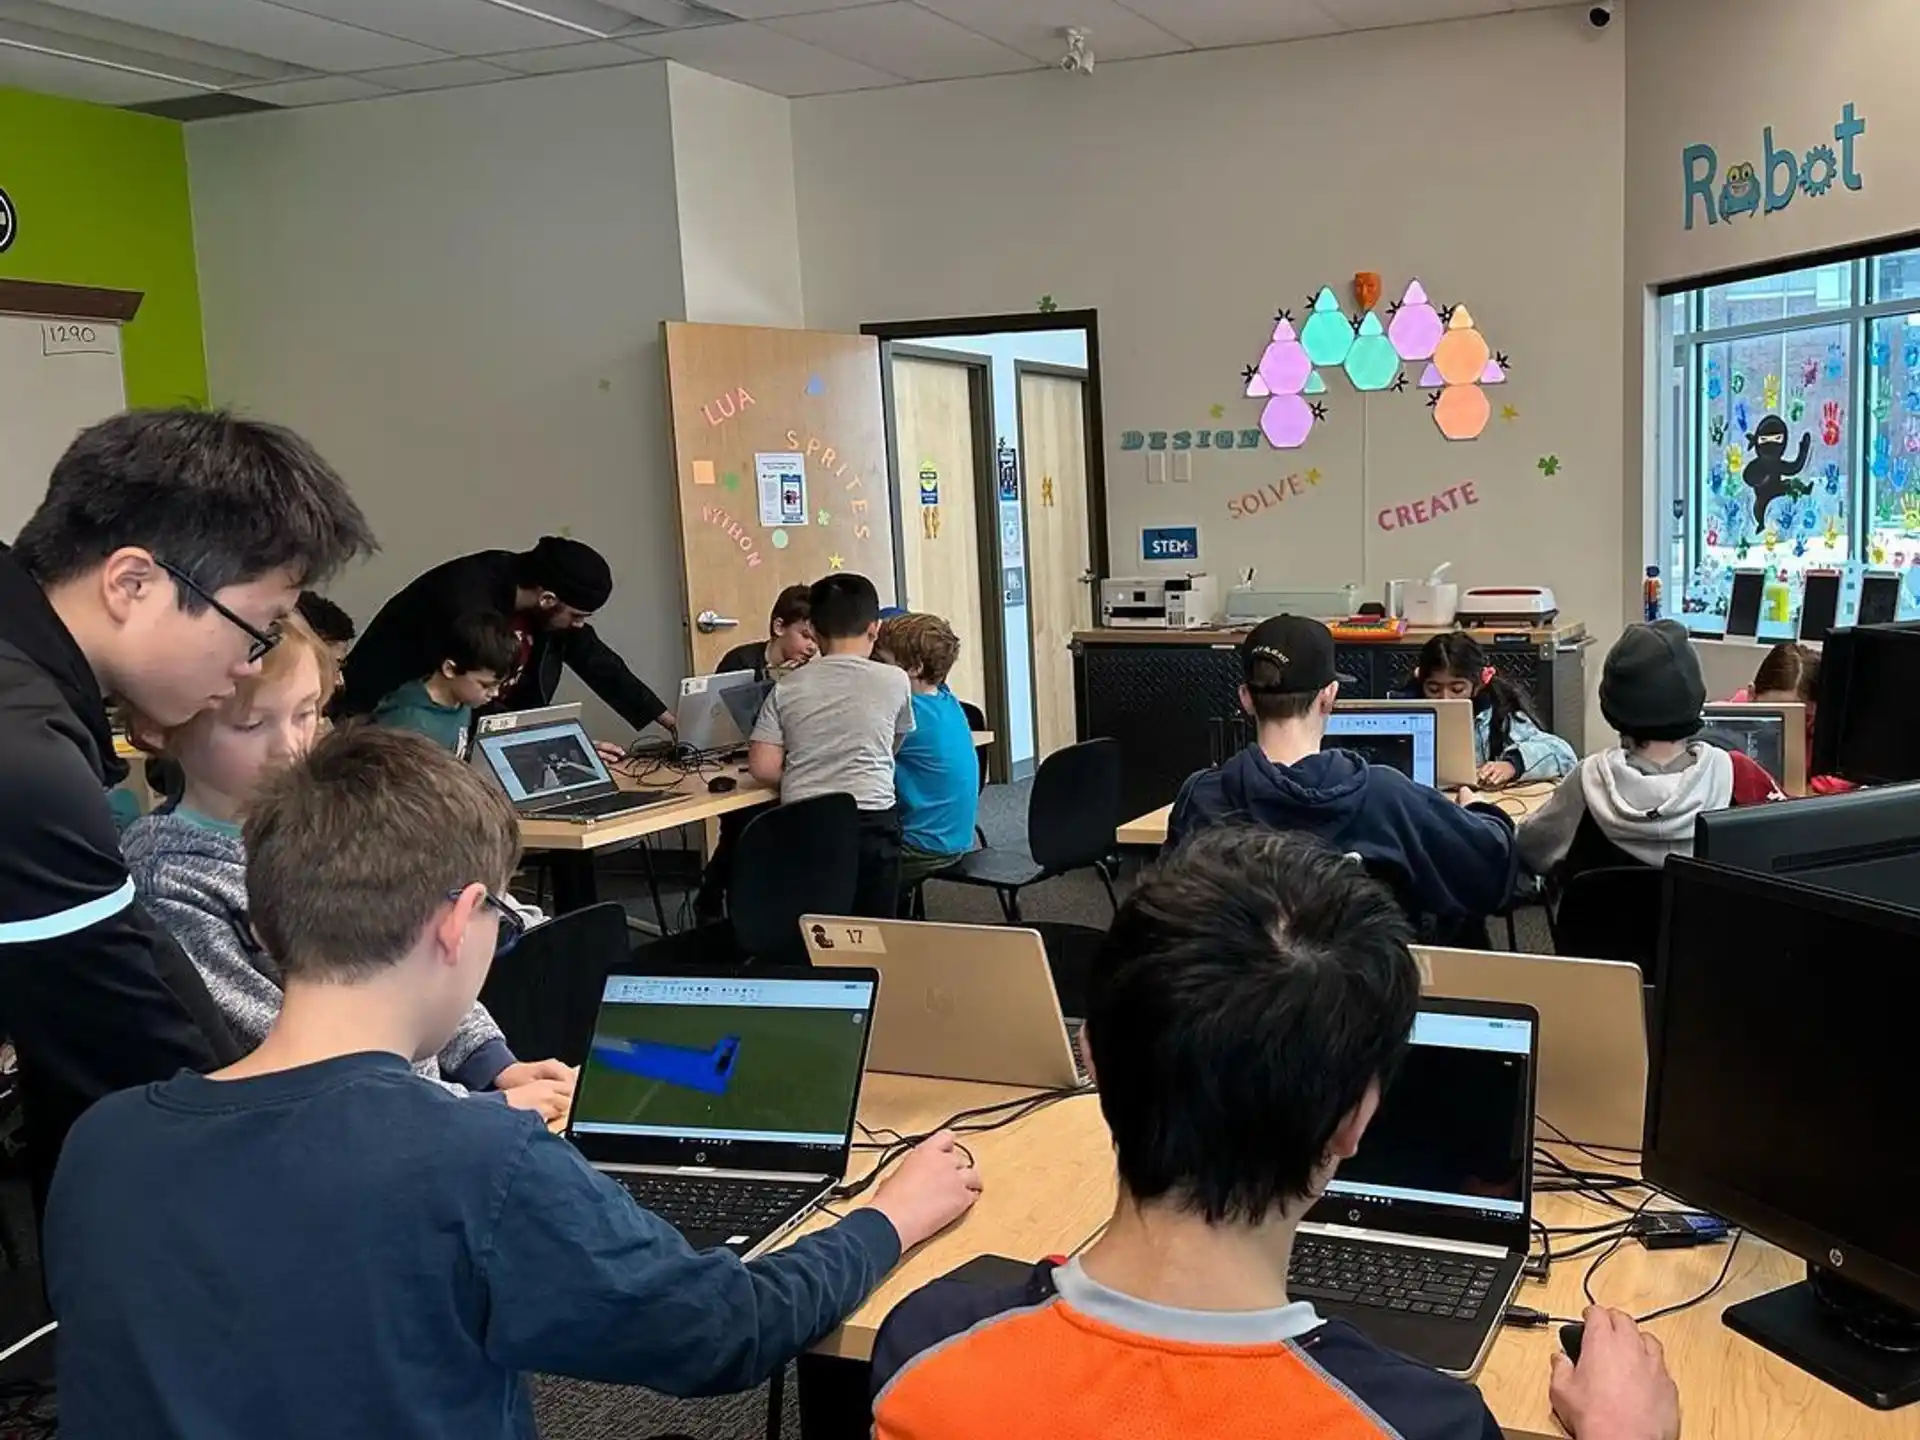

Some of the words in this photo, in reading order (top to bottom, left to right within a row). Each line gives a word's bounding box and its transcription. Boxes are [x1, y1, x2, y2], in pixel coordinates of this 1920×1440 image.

[50, 324, 96, 343] 1290
[702, 387, 757, 426] LUA
[1119, 428, 1261, 450] DESIGN
[785, 429, 871, 543] SPRITES
[1226, 473, 1304, 519] SOLVE
[1377, 481, 1479, 531] CREATE
[1151, 539, 1189, 554] STEM
[846, 929, 863, 944] 17
